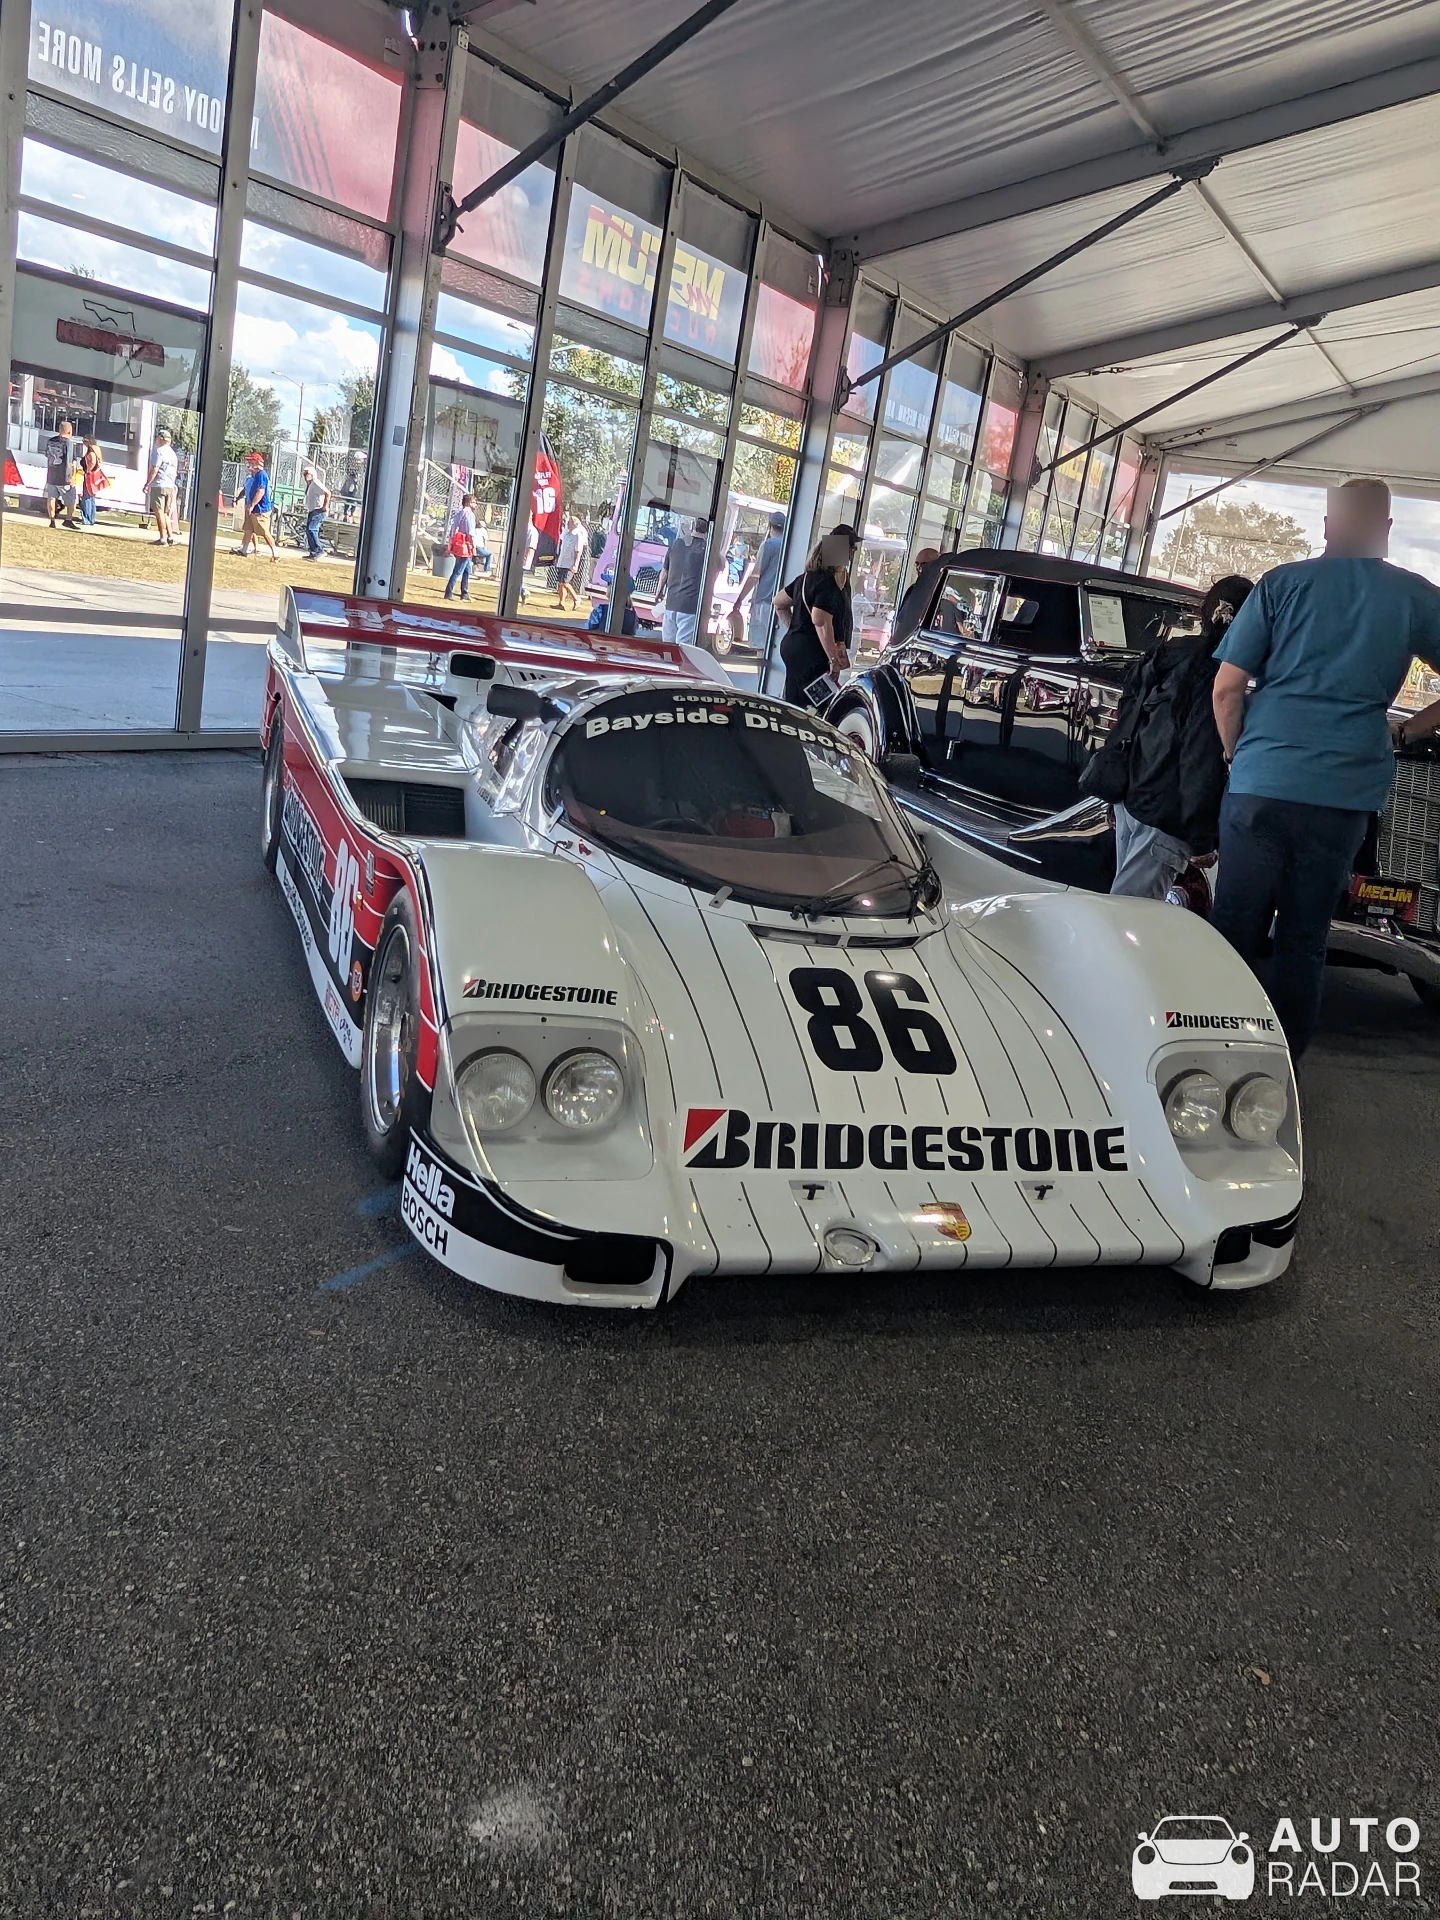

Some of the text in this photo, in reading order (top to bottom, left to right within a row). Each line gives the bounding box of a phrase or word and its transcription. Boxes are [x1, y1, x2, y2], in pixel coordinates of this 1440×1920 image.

[586, 707, 730, 739] Bayside
[328, 838, 360, 986] 86
[1358, 882, 1413, 903] MECUM
[462, 979, 618, 1006] BRIDGESTONE
[788, 966, 958, 1076] 86
[684, 1108, 1129, 1173] BRIDGESTONE
[406, 1141, 456, 1218] Hella
[402, 1188, 449, 1257] BOSCH
